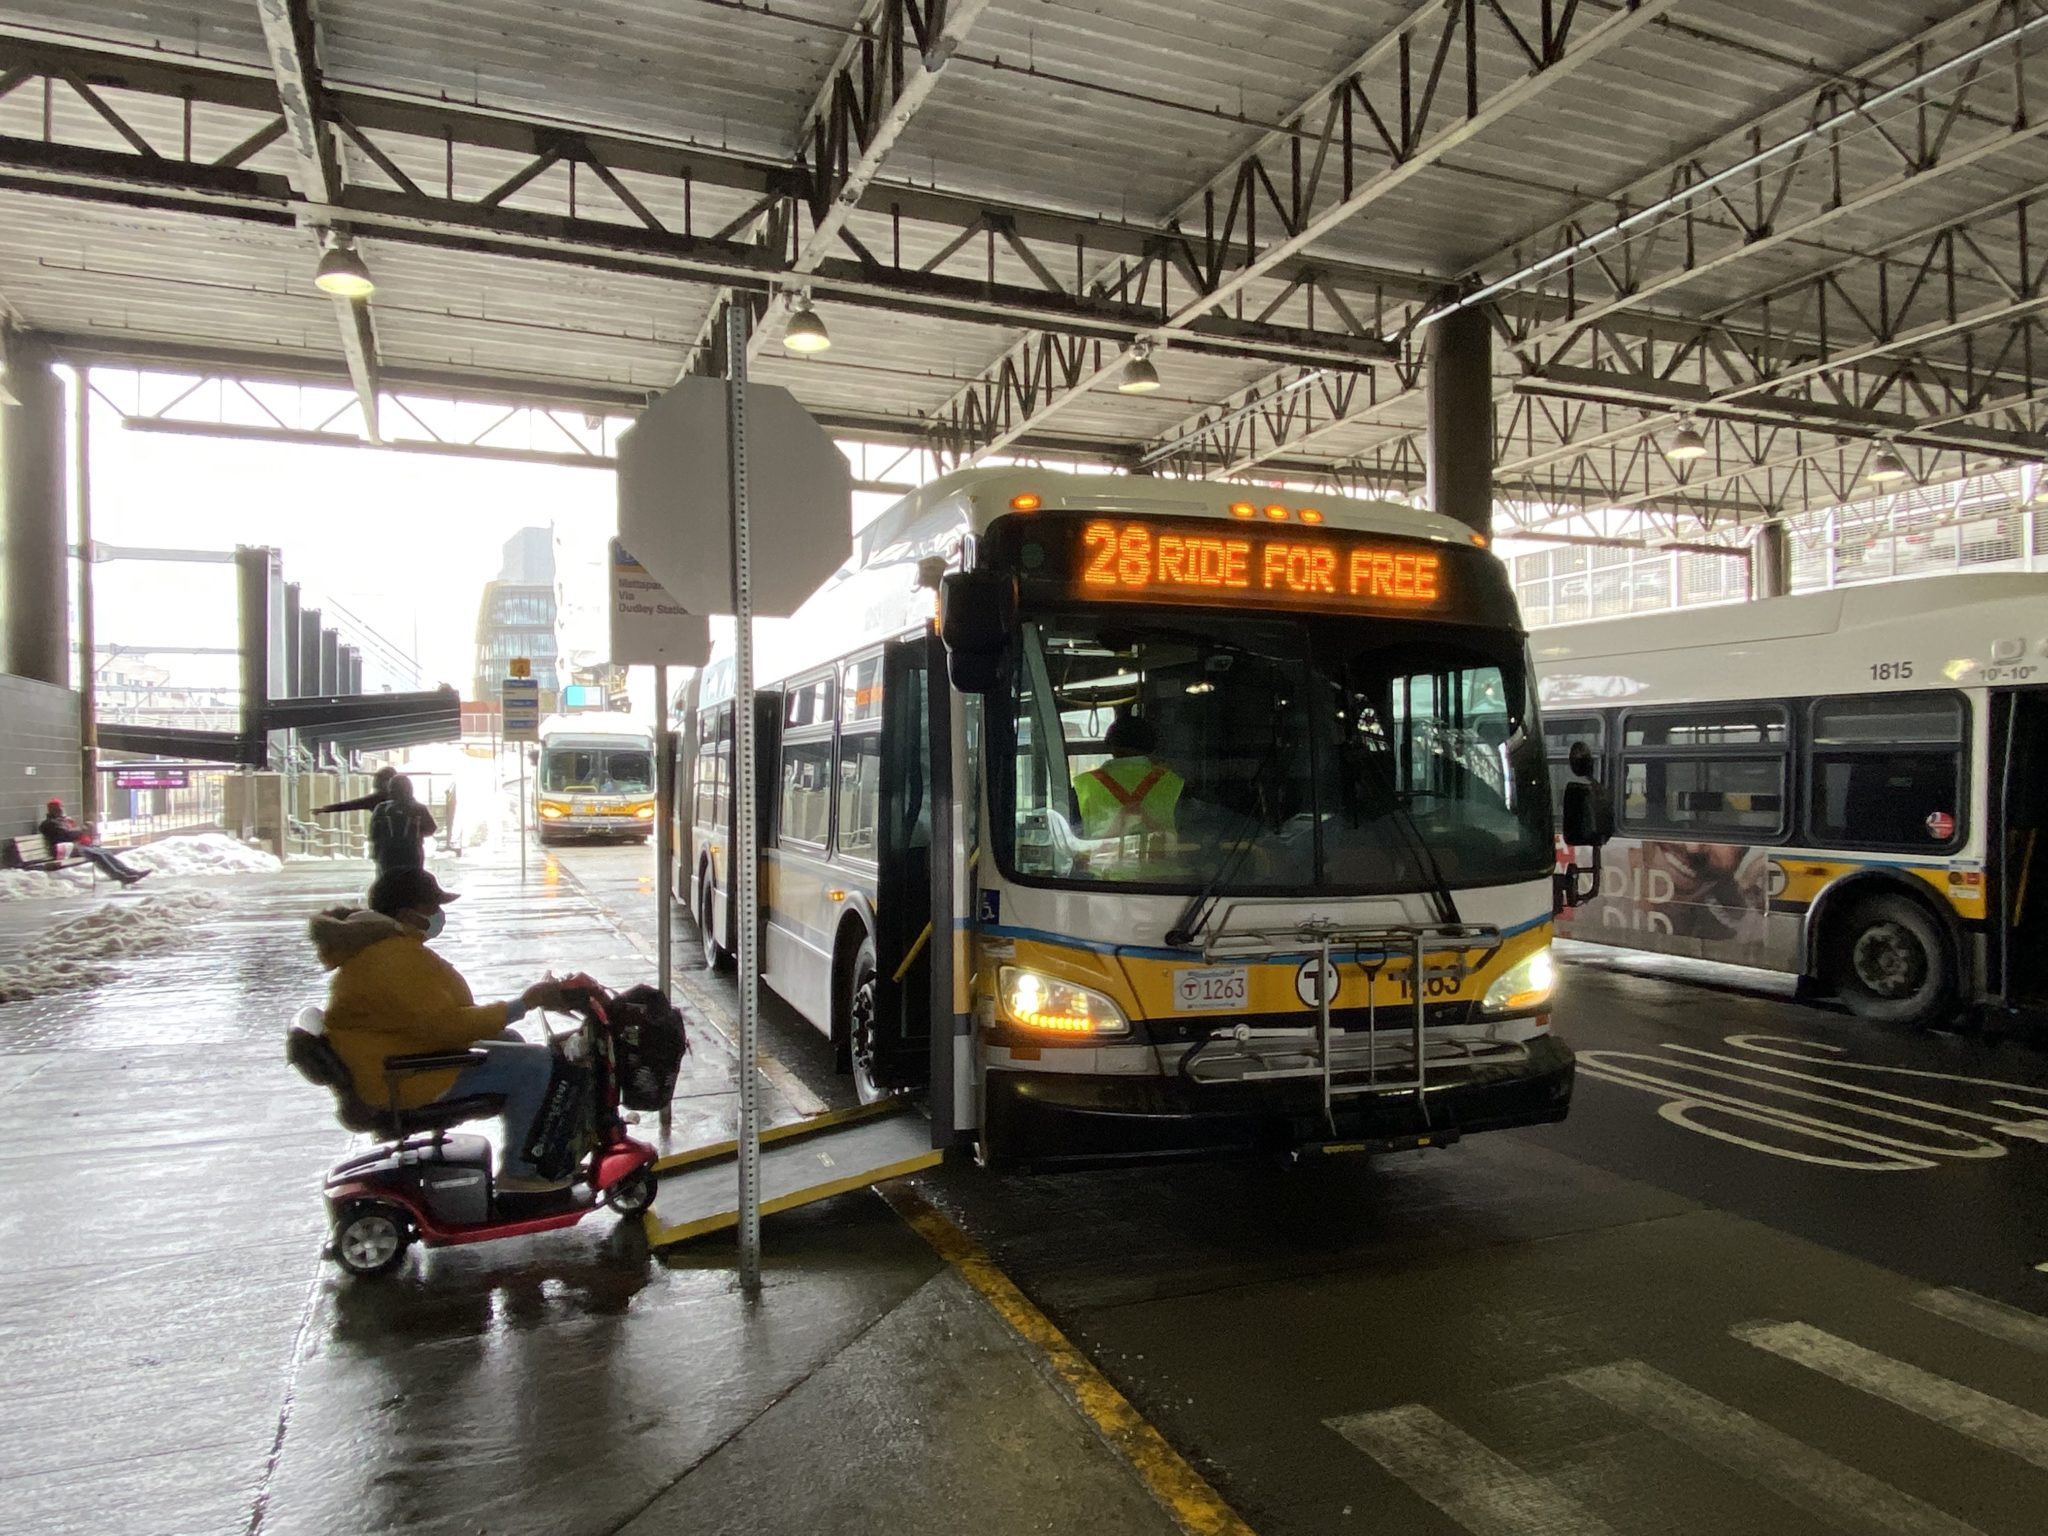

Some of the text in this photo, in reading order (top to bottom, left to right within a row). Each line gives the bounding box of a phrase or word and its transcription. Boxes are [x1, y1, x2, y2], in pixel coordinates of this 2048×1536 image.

[1085, 524, 1438, 599] 28 RIDE FOR FREE
[619, 591, 634, 600] Via
[619, 603, 653, 615] Dudley
[1870, 661, 1913, 681] 1815
[1203, 978, 1245, 1000] 1263
